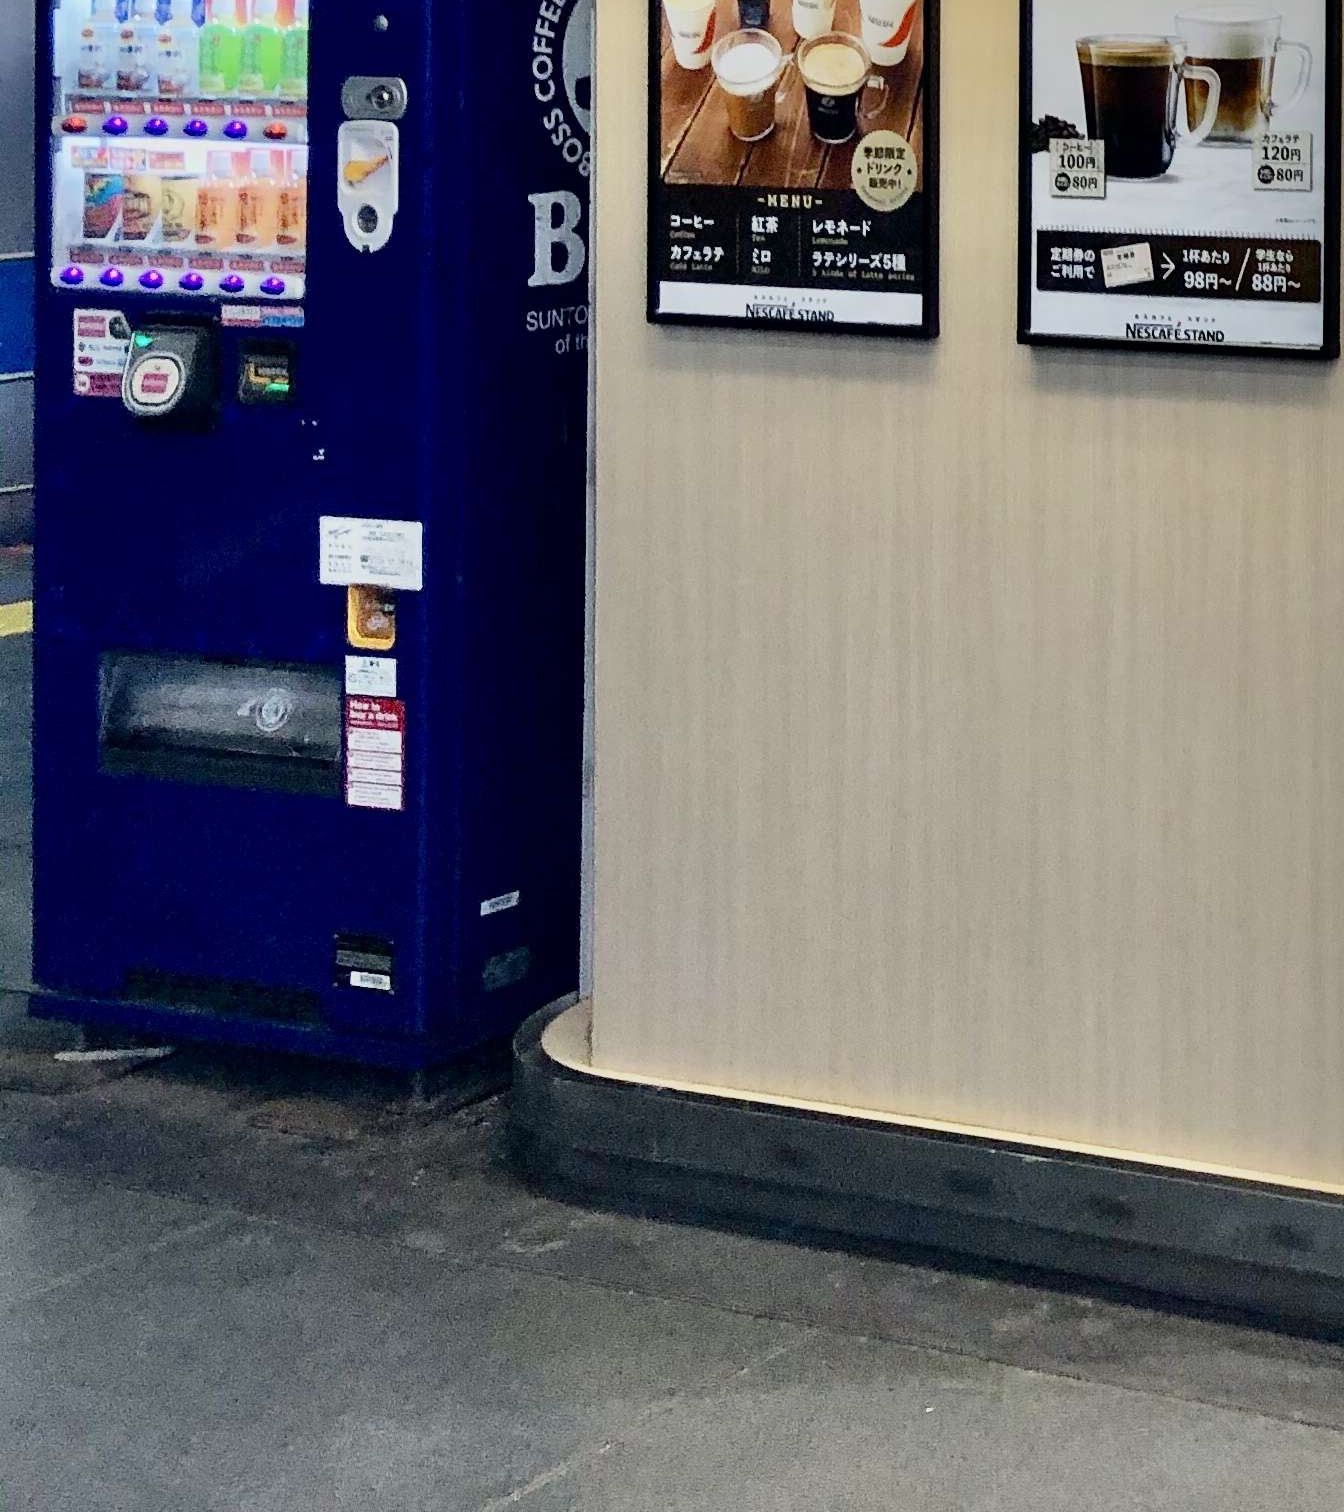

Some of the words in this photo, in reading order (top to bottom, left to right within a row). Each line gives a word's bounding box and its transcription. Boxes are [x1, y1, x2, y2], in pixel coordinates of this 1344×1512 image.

[1058, 154, 1096, 170] 100円
[1261, 146, 1301, 162] 120円
[1072, 175, 1098, 190] 80円
[1276, 168, 1304, 182] 80円
[670, 215, 715, 230] コーヒー
[751, 215, 779, 233] 紅茶
[812, 219, 871, 237] レモネード
[670, 245, 725, 262] カフェラテ
[752, 248, 772, 265] ミロ
[812, 250, 907, 272] ラテシリーズ5種
[1182, 249, 1230, 265] 1杯あたり
[1050, 265, 1095, 280] ご利用で
[1183, 328, 1225, 343] STAND
[555, 334, 571, 355] of
